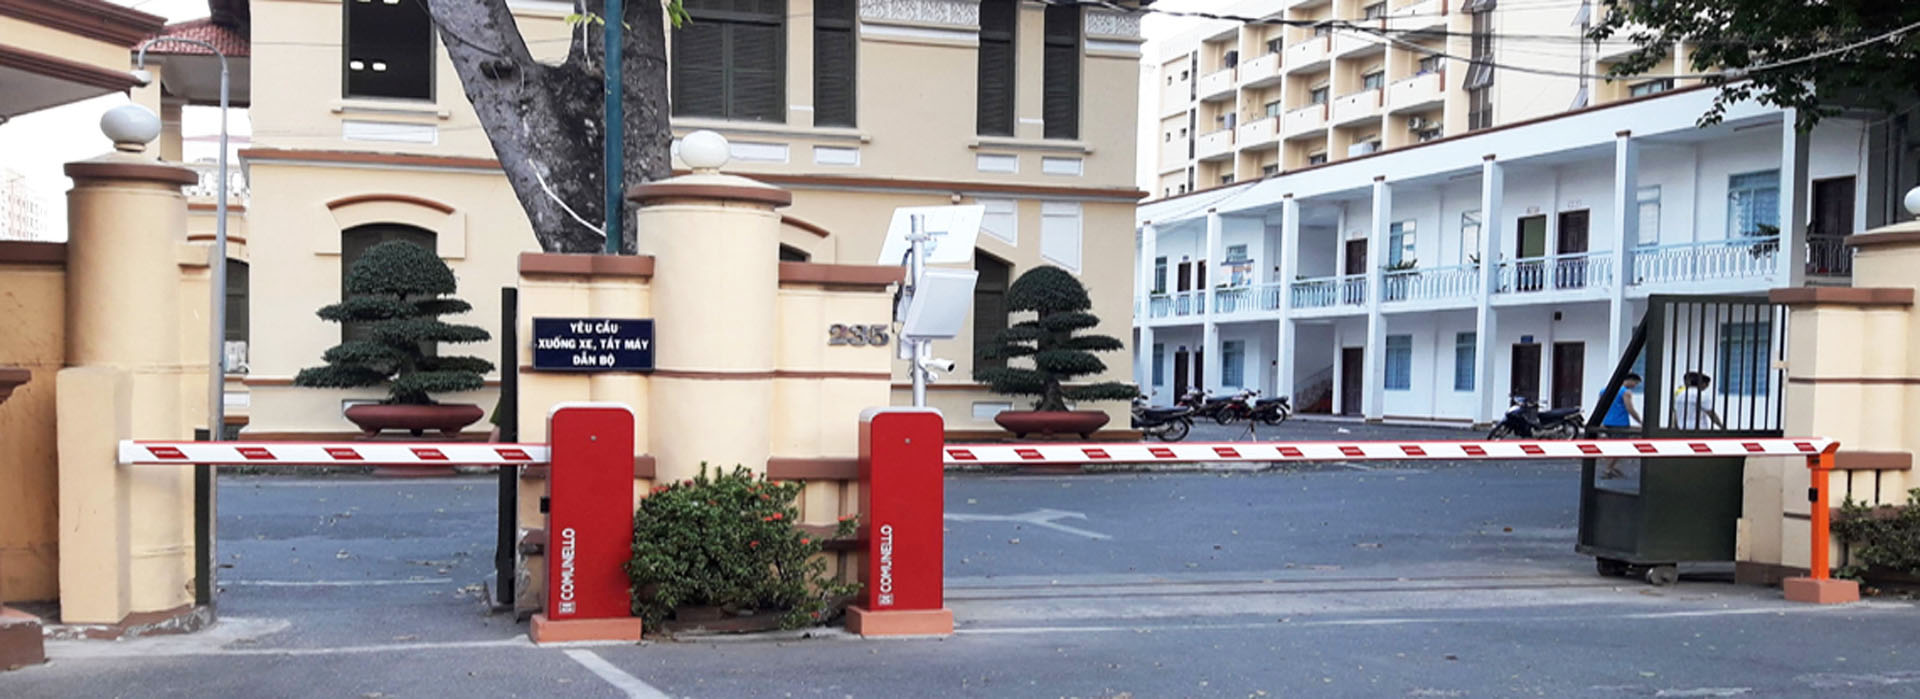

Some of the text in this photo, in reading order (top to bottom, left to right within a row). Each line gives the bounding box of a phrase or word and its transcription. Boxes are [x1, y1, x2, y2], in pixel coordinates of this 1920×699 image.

[570, 320, 592, 333] YÊU
[828, 324, 890, 348] 235
[538, 335, 576, 349] XUỐNG
[579, 338, 597, 351] XE,
[624, 337, 649, 349] MÁY
[560, 527, 576, 601] COMUNELLO
[880, 524, 893, 593] COMUNELLO
